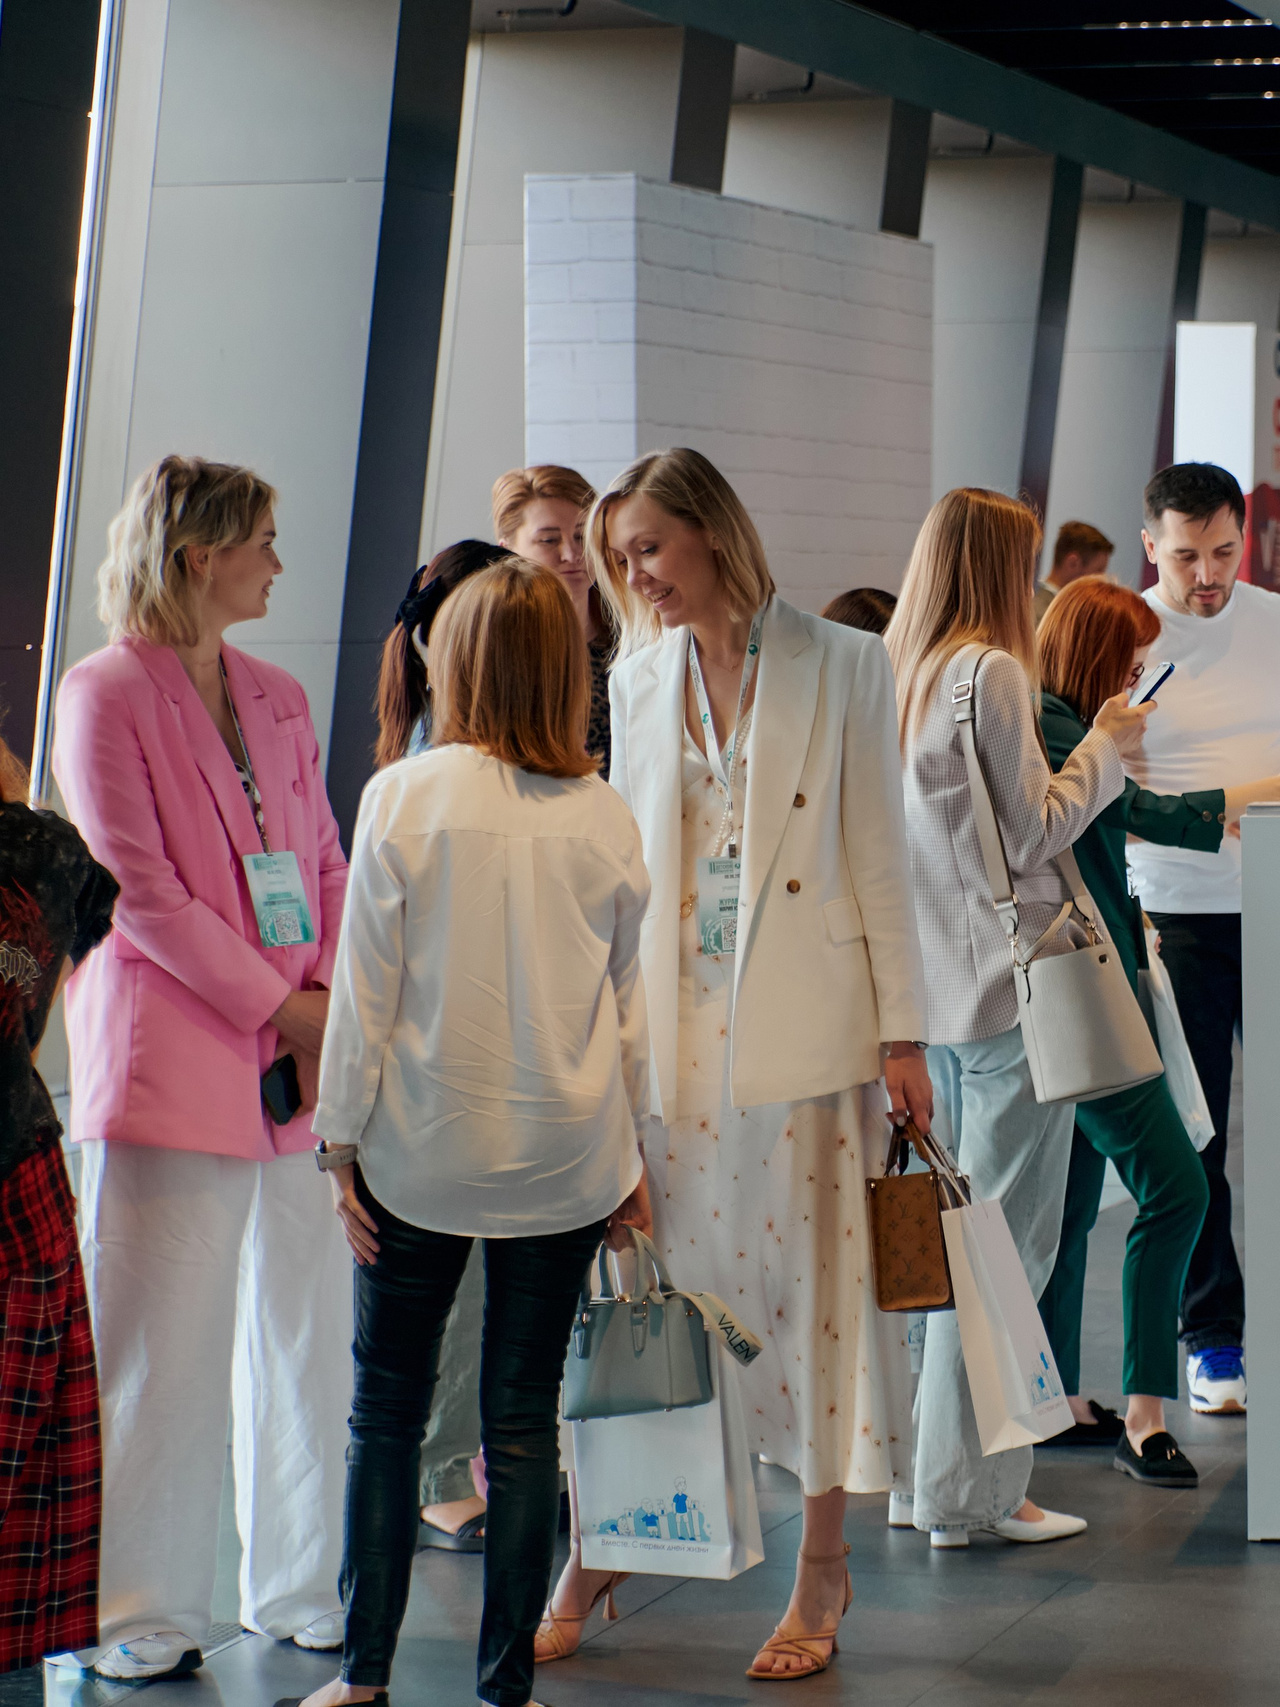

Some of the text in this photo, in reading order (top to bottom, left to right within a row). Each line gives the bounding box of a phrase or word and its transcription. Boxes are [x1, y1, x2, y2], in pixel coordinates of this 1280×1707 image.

[601, 1538, 630, 1548] Вместе.
[631, 1540, 638, 1549] С
[639, 1541, 666, 1552] первых
